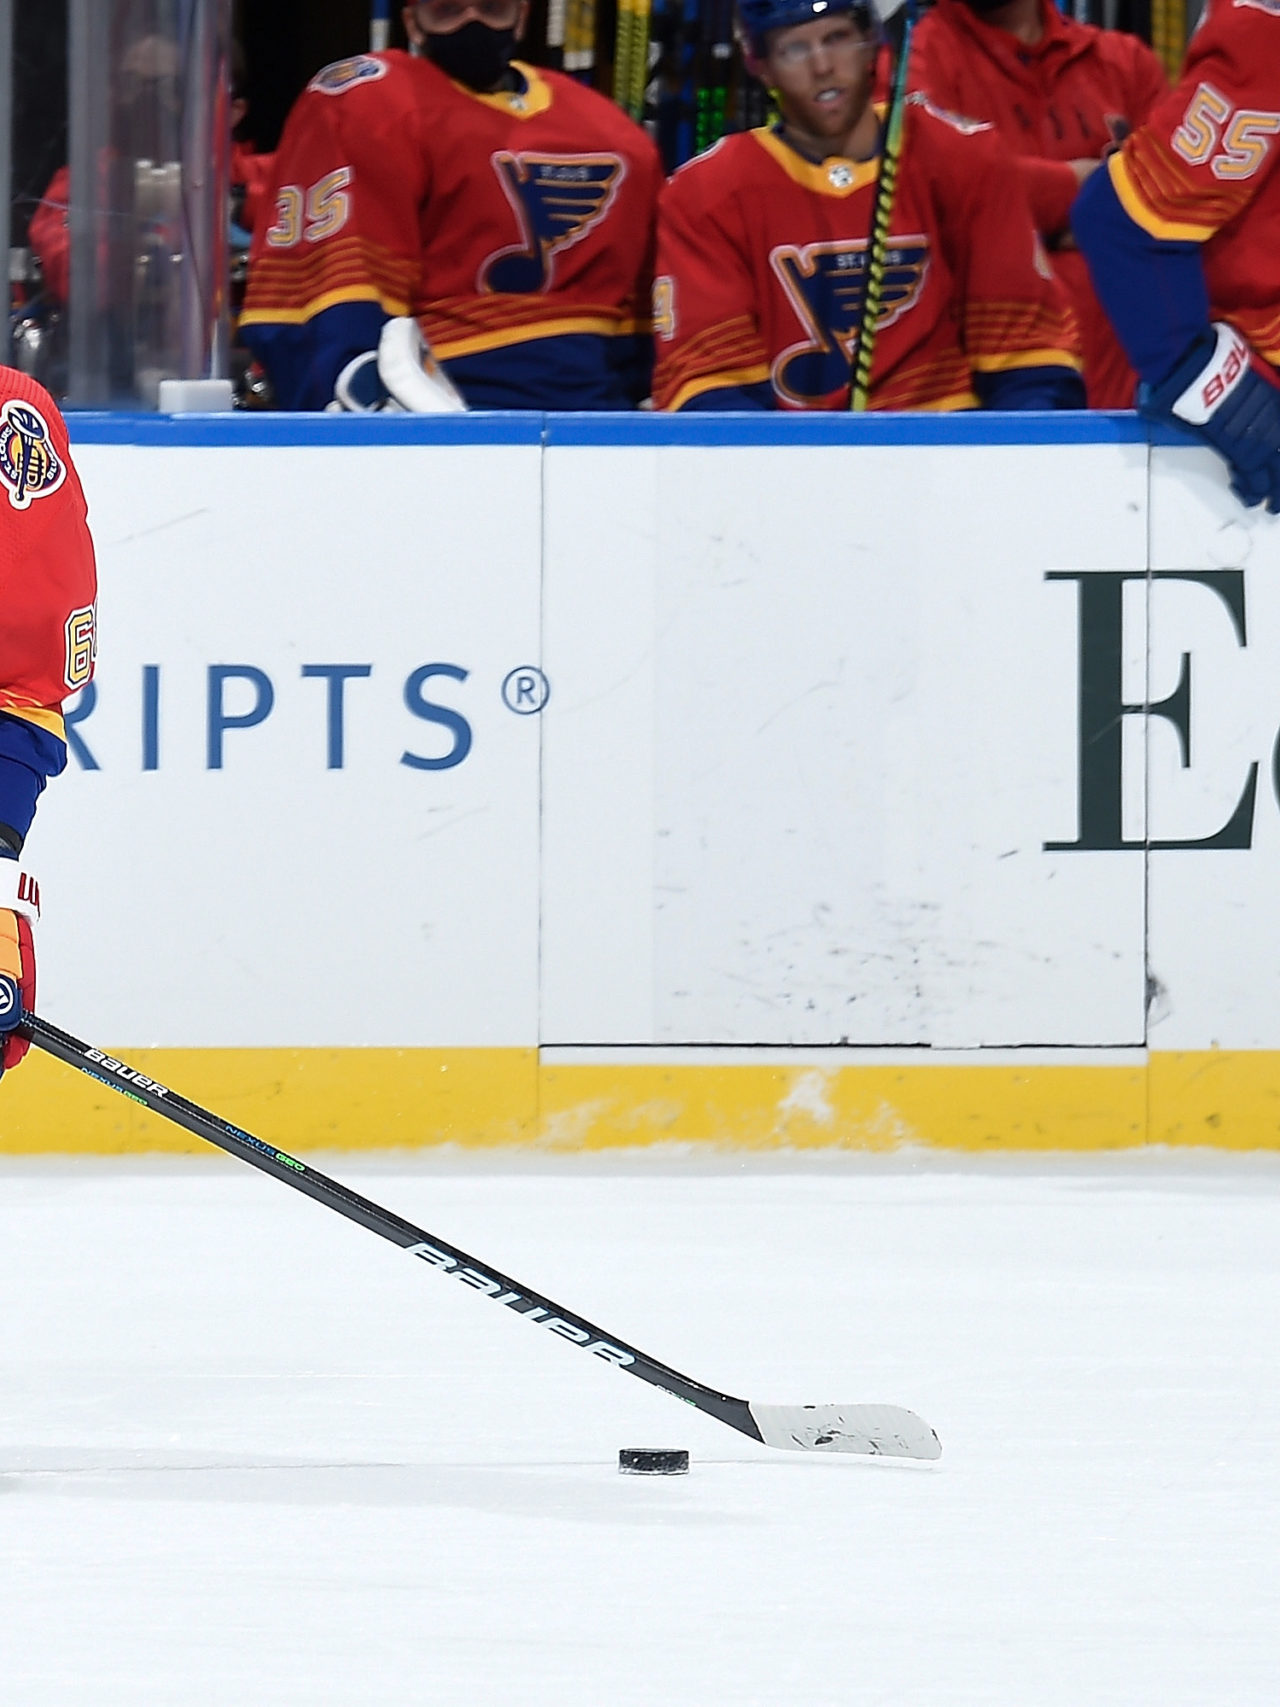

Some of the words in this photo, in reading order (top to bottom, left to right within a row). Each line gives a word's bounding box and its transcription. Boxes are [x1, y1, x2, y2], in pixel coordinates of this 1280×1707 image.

[1171, 82, 1280, 180] 55
[266, 167, 351, 247] 35
[63, 604, 96, 691] 6
[1041, 569, 1280, 851] E
[225, 1125, 275, 1156] NEXUS
